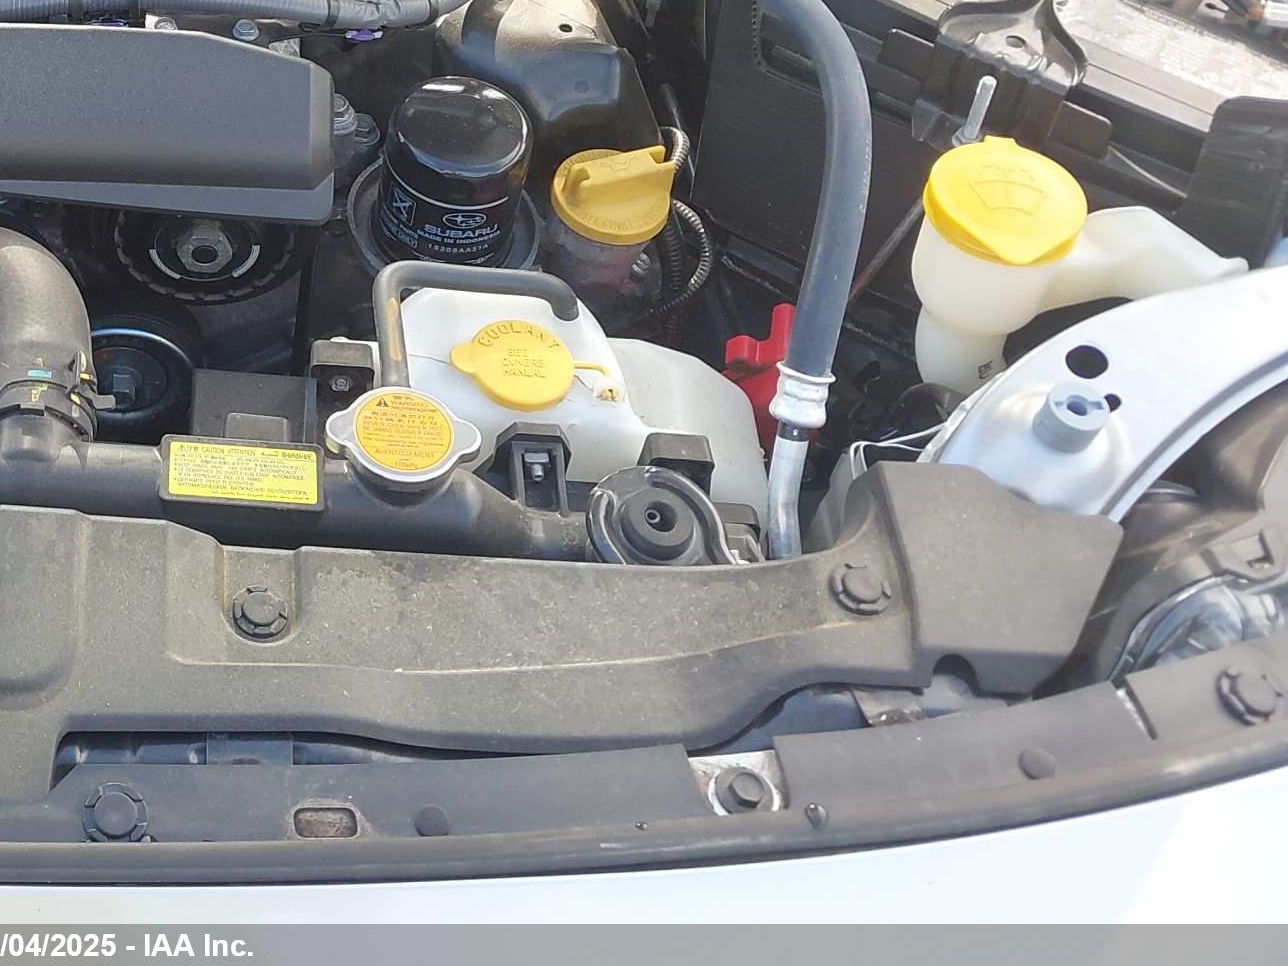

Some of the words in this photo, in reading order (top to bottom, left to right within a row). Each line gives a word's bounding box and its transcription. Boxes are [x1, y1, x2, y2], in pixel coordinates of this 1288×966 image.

[417, 229, 442, 242] MADE
[456, 230, 501, 244] INDONESIA
[424, 223, 498, 238] SUBARU
[477, 322, 561, 348] COOLANT
[503, 369, 546, 379] MANUAL
[375, 448, 434, 459] AVERTISSEMENT
